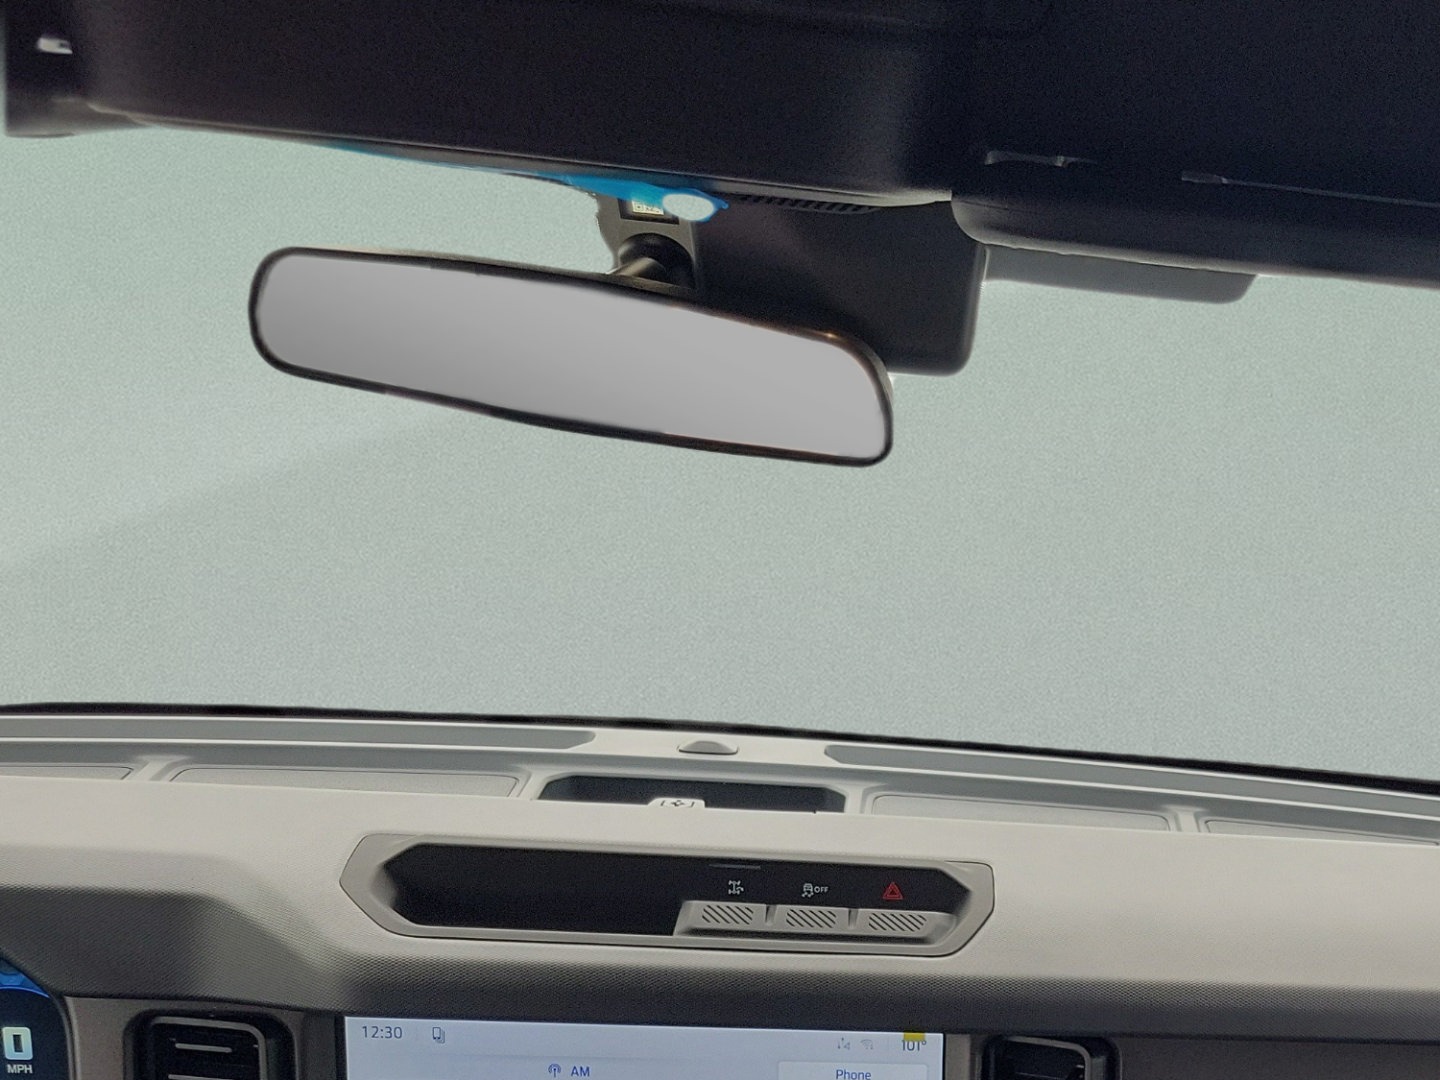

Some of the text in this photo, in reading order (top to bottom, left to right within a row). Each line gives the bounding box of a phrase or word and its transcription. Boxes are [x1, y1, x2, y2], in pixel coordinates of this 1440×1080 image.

[362, 1026, 402, 1039] 12:30
[2, 1026, 34, 1060] 0
[7, 1064, 33, 1074] MPH
[570, 1066, 590, 1077] AM
[835, 1069, 872, 1080] Phone
